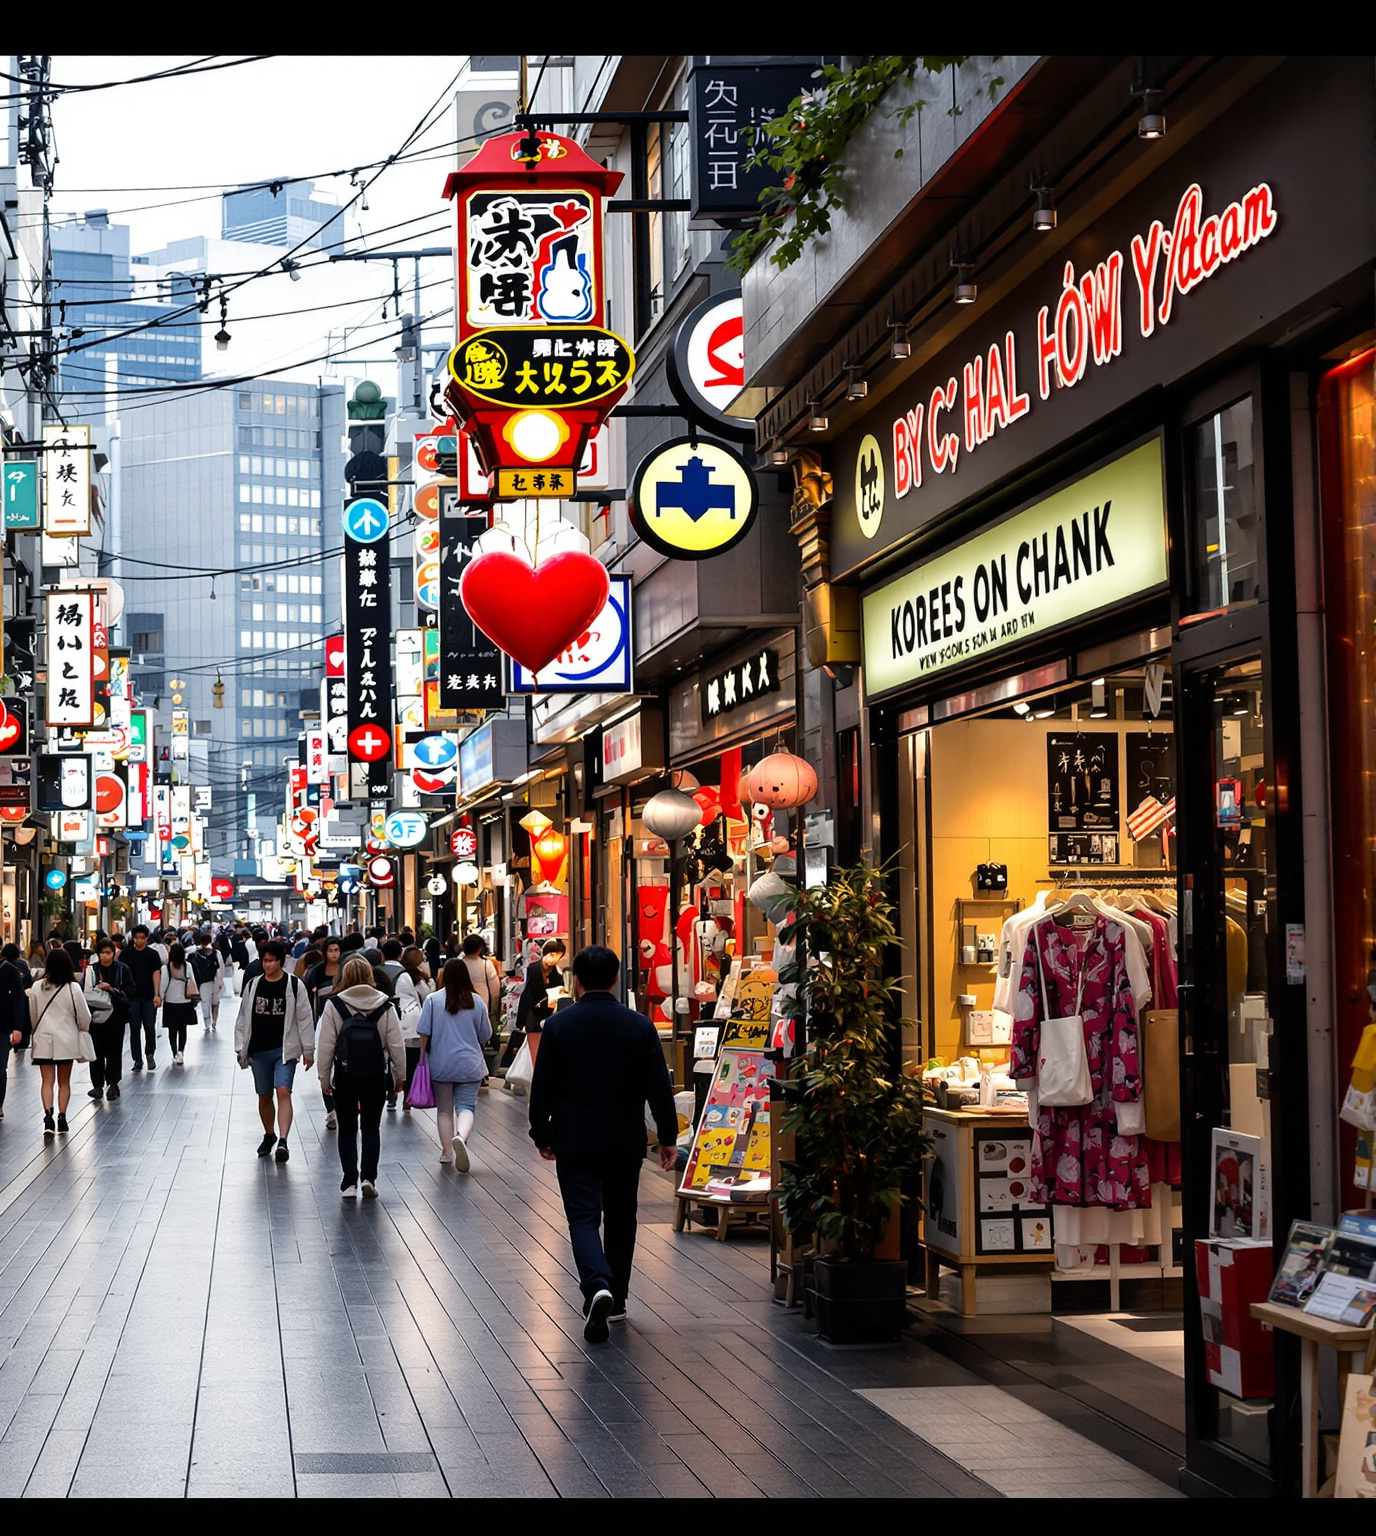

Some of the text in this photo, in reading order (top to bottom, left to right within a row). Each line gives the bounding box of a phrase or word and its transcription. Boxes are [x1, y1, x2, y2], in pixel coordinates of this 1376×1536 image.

[893, 403, 924, 499] BY
[963, 331, 1029, 452] HAL
[891, 500, 1115, 659] KOREES ON CHANK
